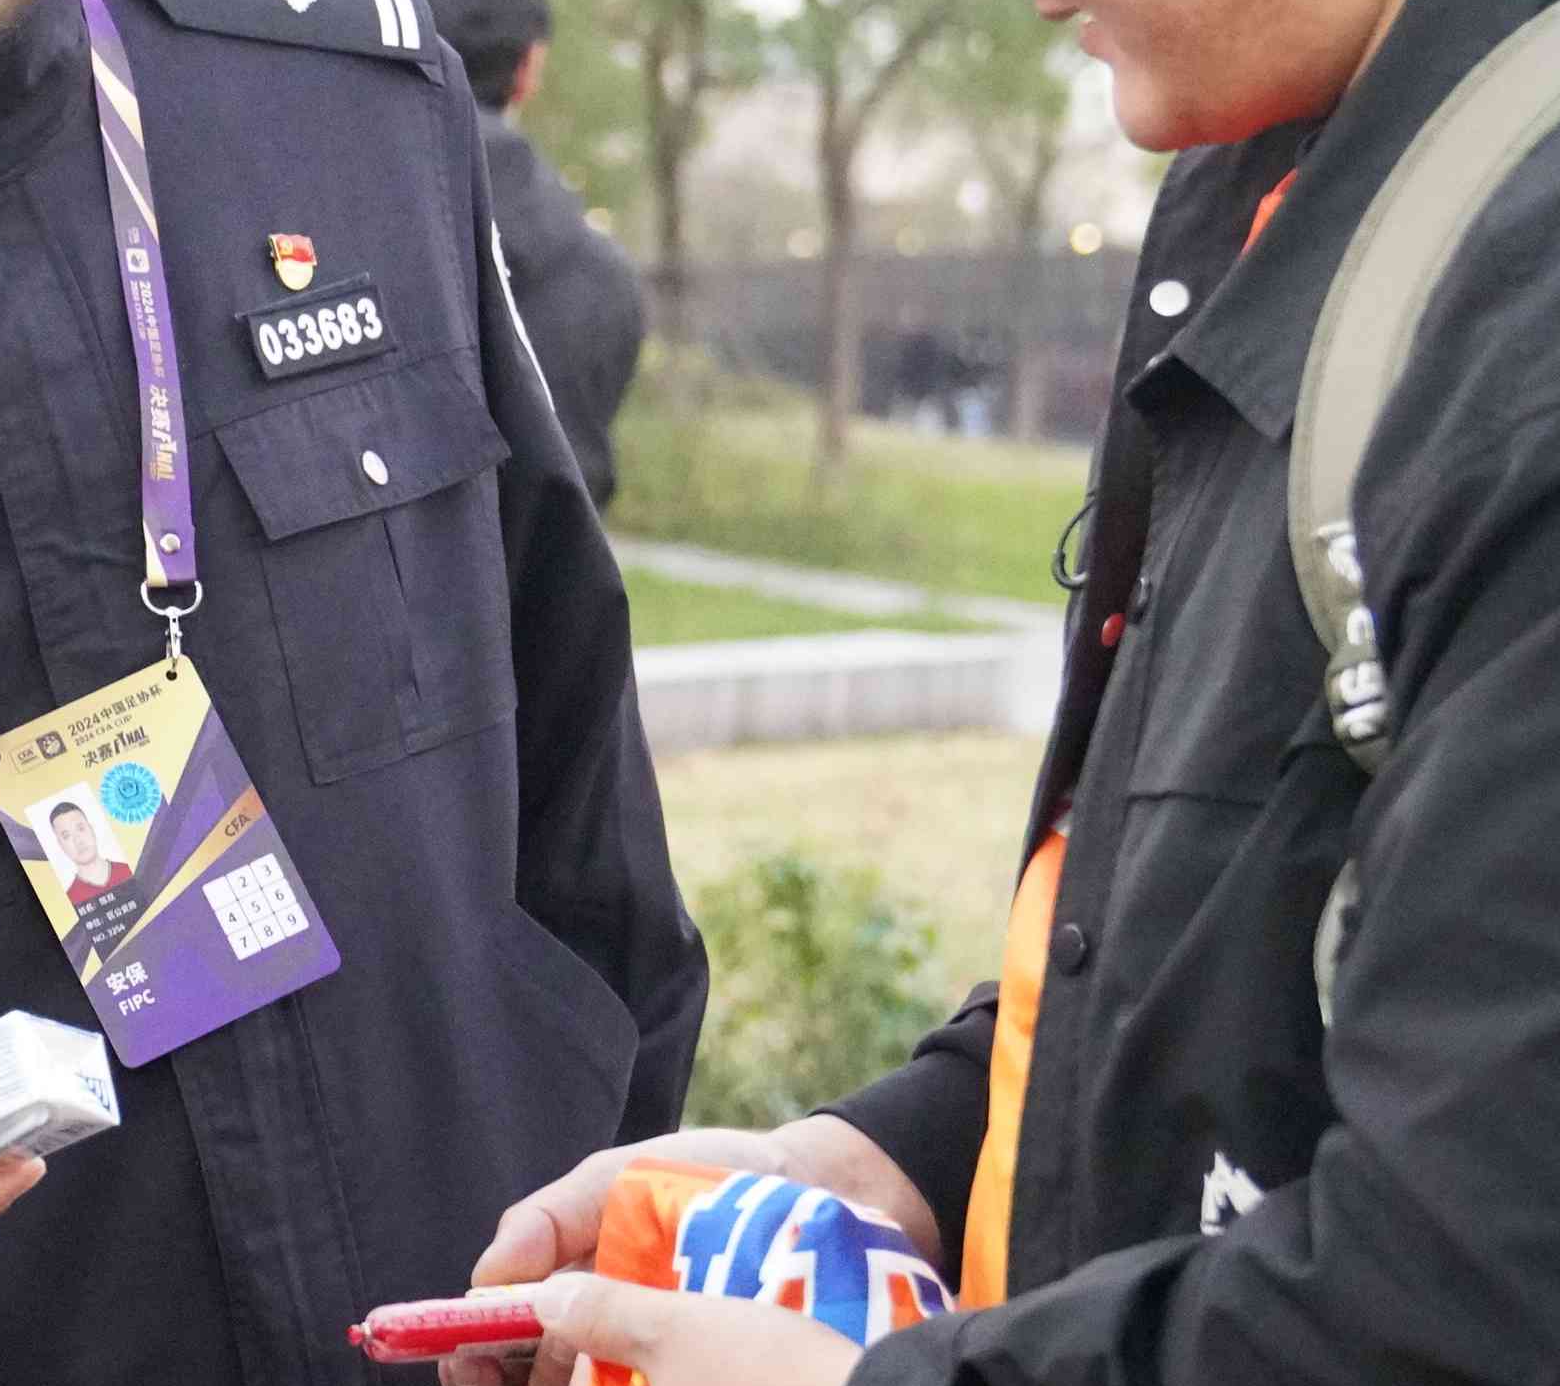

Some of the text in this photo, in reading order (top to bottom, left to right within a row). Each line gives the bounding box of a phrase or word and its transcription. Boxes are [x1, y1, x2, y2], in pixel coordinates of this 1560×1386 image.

[259, 297, 382, 366] 033683
[68, 684, 162, 736] 2024中国足协杯
[224, 813, 249, 838] CFA
[105, 961, 149, 995] 安保
[118, 989, 156, 1016] FIPC
